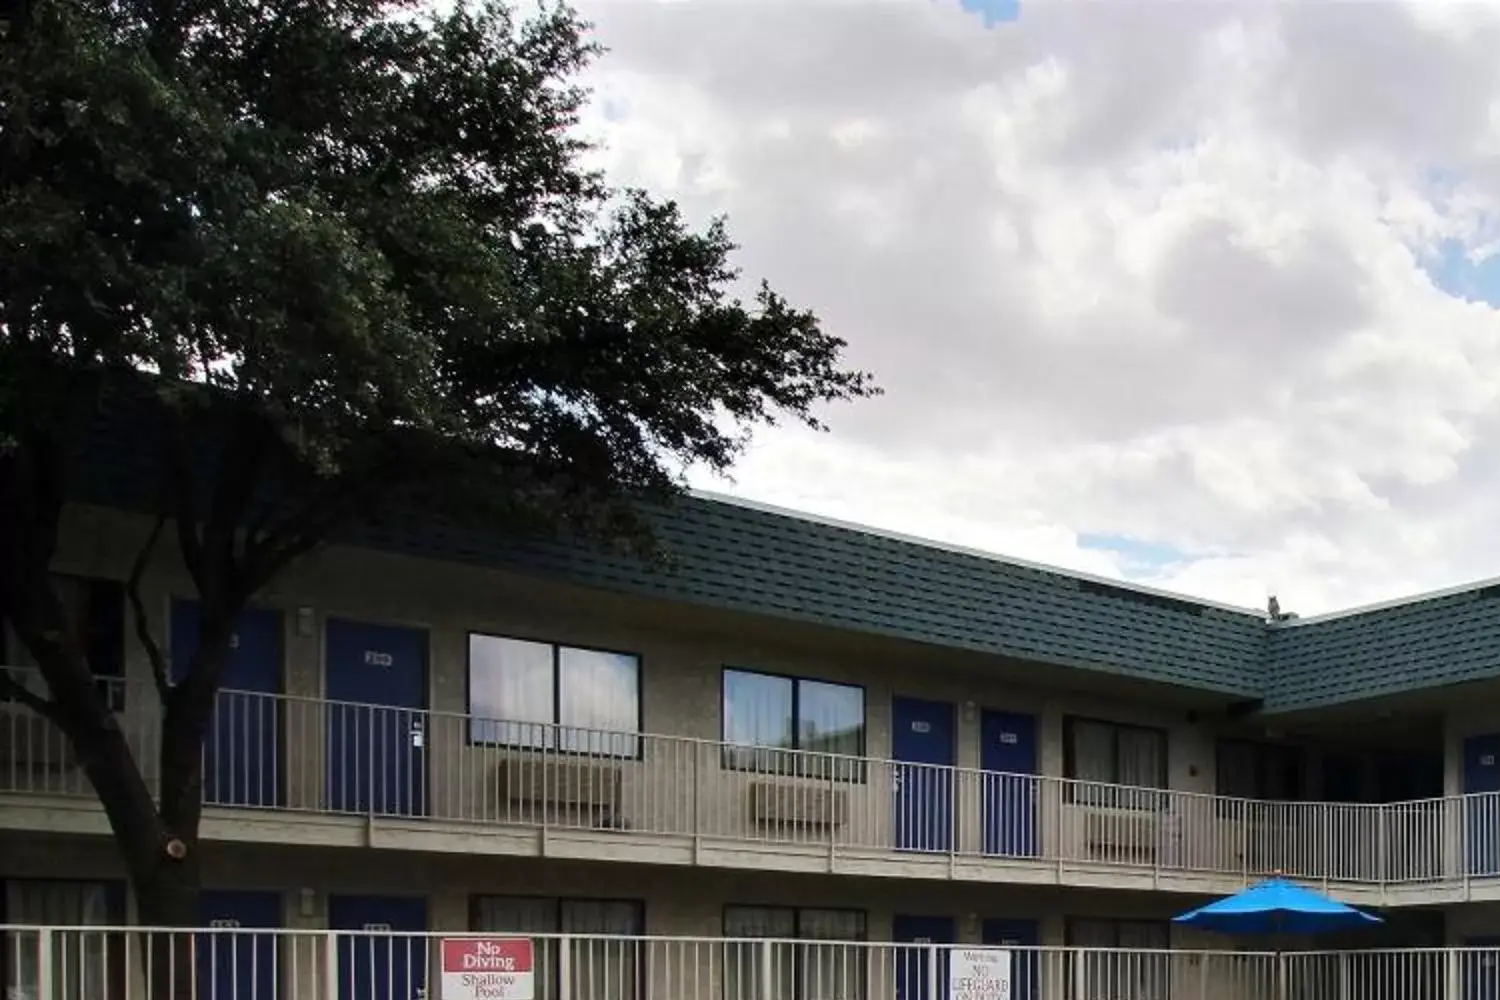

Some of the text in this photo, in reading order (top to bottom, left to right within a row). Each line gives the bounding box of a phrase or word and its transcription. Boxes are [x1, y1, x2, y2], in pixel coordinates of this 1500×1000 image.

[477, 942, 500, 955] No
[463, 953, 516, 970] Diving
[463, 974, 513, 986] Shallow
[475, 986, 505, 998] Pool
